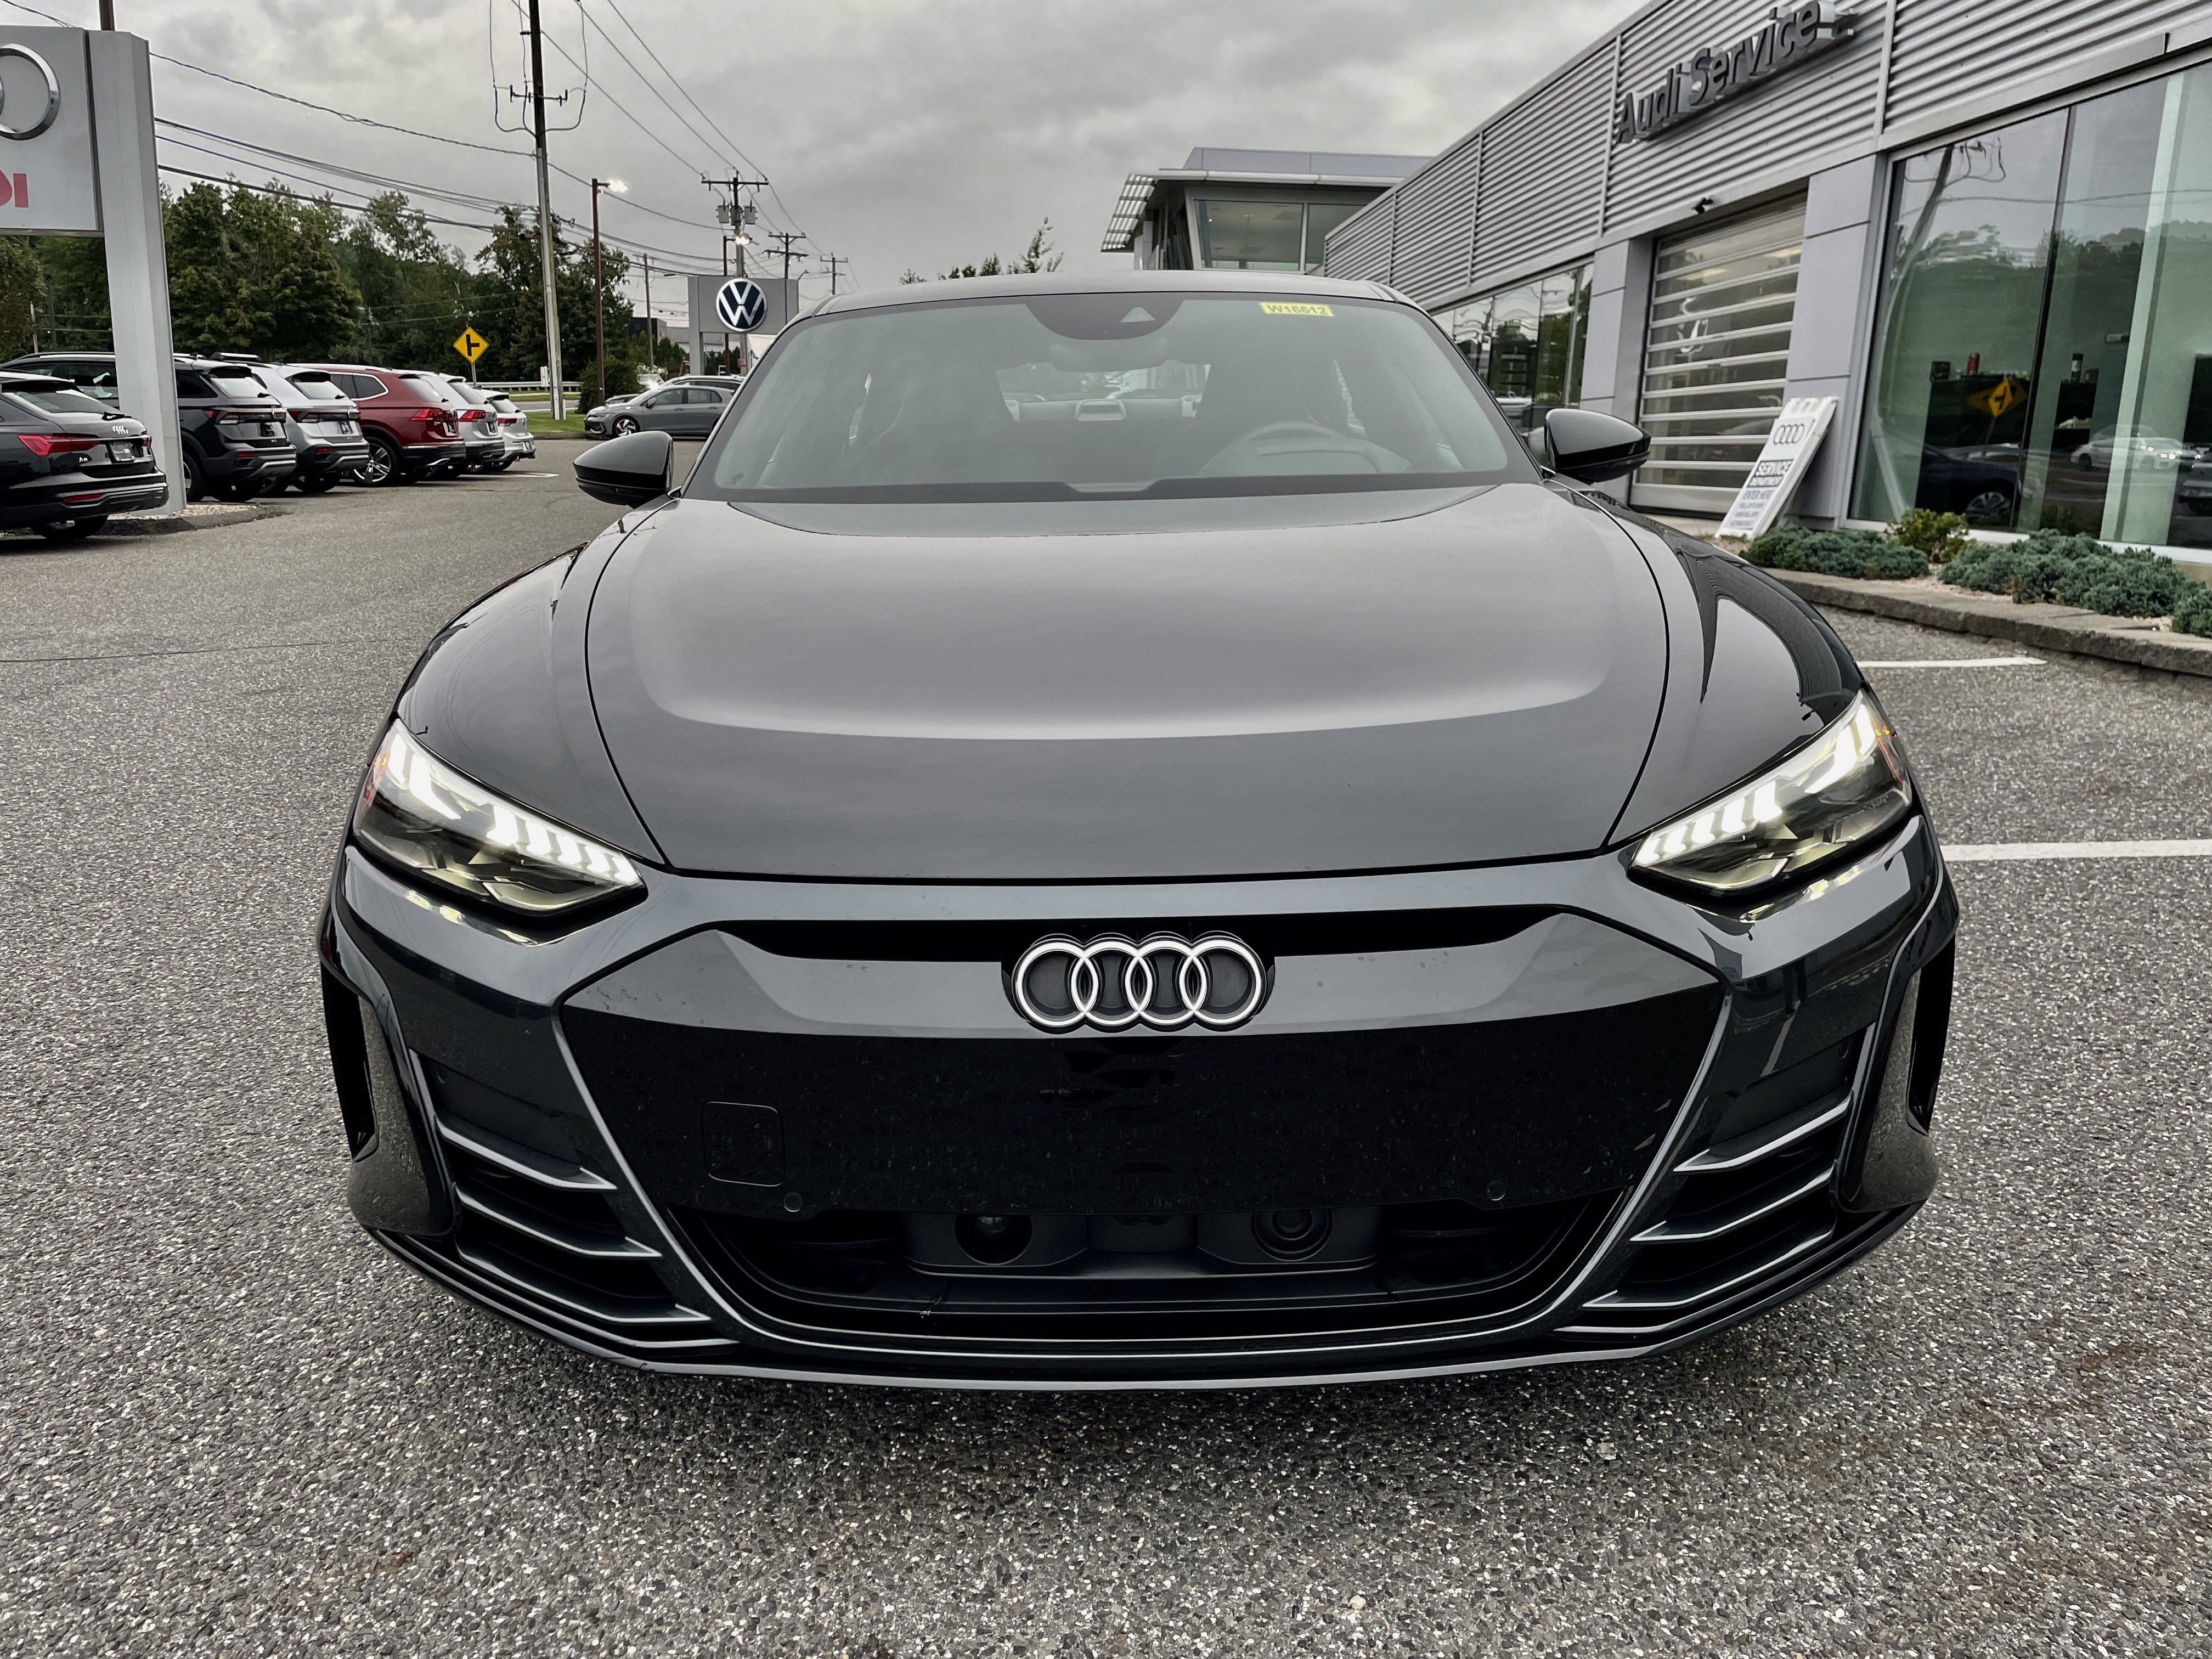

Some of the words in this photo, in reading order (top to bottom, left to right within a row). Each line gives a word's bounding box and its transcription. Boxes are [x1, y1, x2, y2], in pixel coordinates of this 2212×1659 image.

[1617, 63, 1689, 143] Audi
[1690, 2, 1827, 106] Service
[1267, 305, 1328, 314] W16612
[1755, 460, 1791, 476] SERVICE
